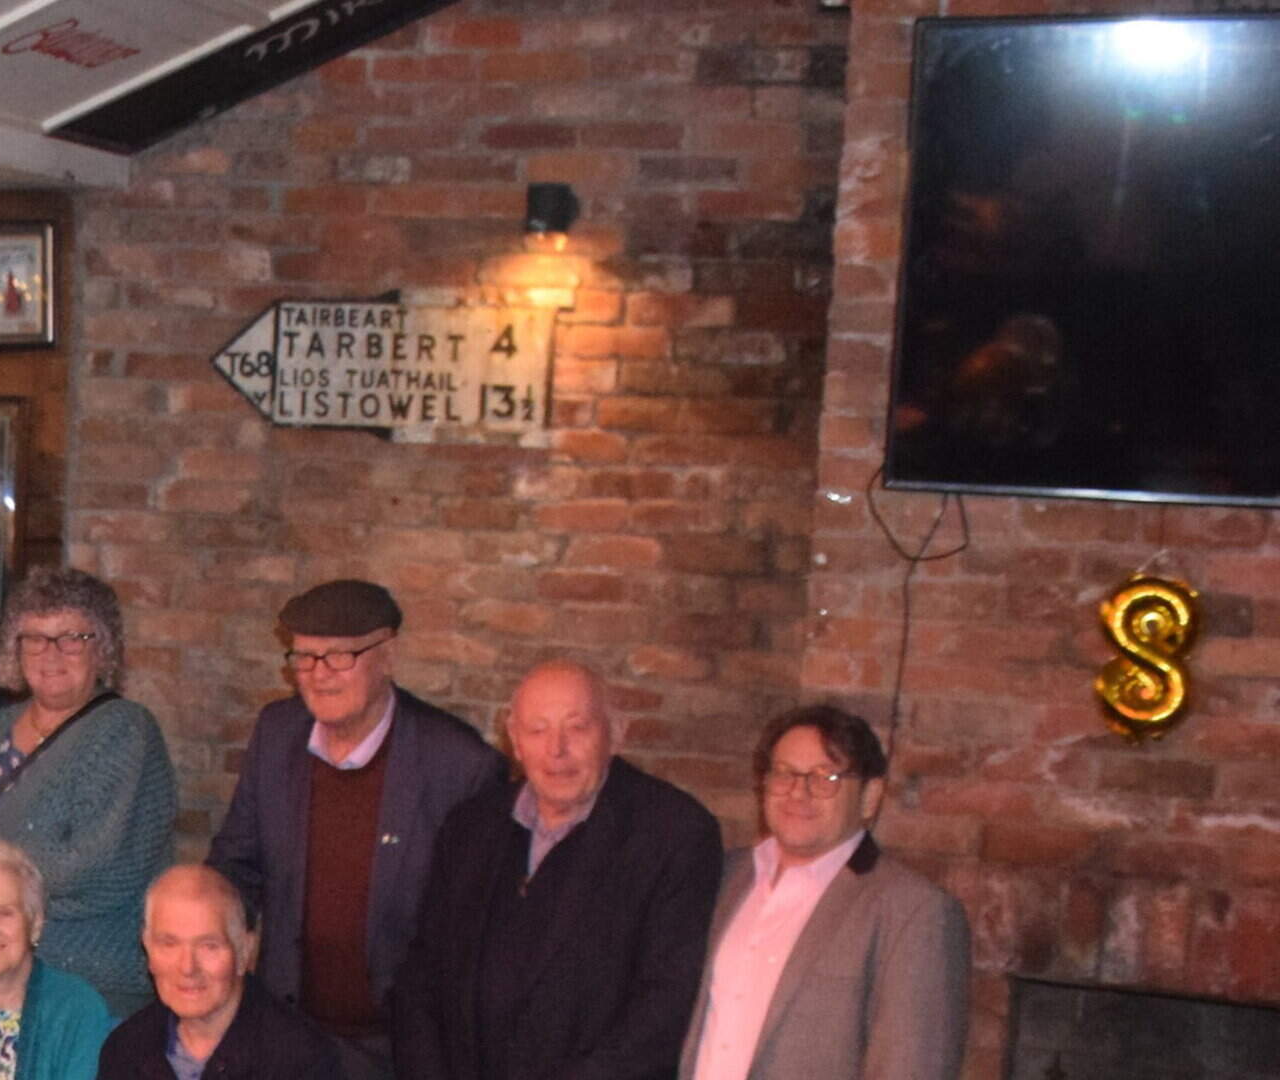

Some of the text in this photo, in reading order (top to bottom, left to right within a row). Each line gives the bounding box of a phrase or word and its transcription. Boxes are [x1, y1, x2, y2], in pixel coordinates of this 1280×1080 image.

[284, 307, 408, 330] TAIRBEART
[283, 323, 517, 362] TARBERT 4
[224, 349, 273, 377] T68
[280, 369, 458, 392] LIOS TUATHAIL
[278, 391, 461, 421] LISTOWEL
